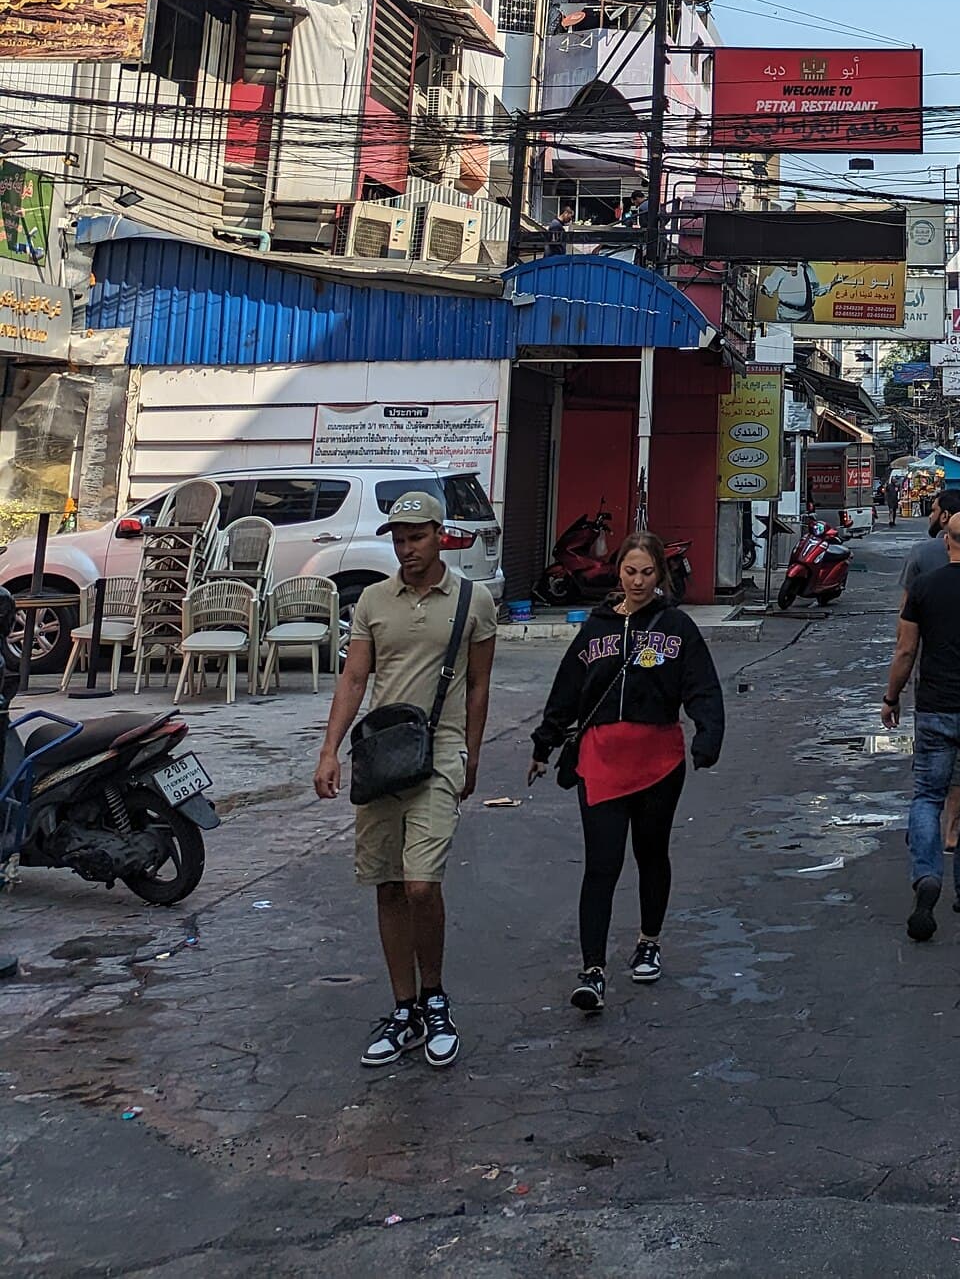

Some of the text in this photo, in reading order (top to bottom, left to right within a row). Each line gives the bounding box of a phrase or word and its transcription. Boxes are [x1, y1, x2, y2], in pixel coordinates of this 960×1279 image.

[783, 85, 852, 96] WELCOME TO
[756, 100, 878, 112] PETRA RESTAURANT
[388, 408, 423, 417] ประกาศ
[578, 630, 682, 667] LAKERS
[173, 777, 205, 801] 9812
